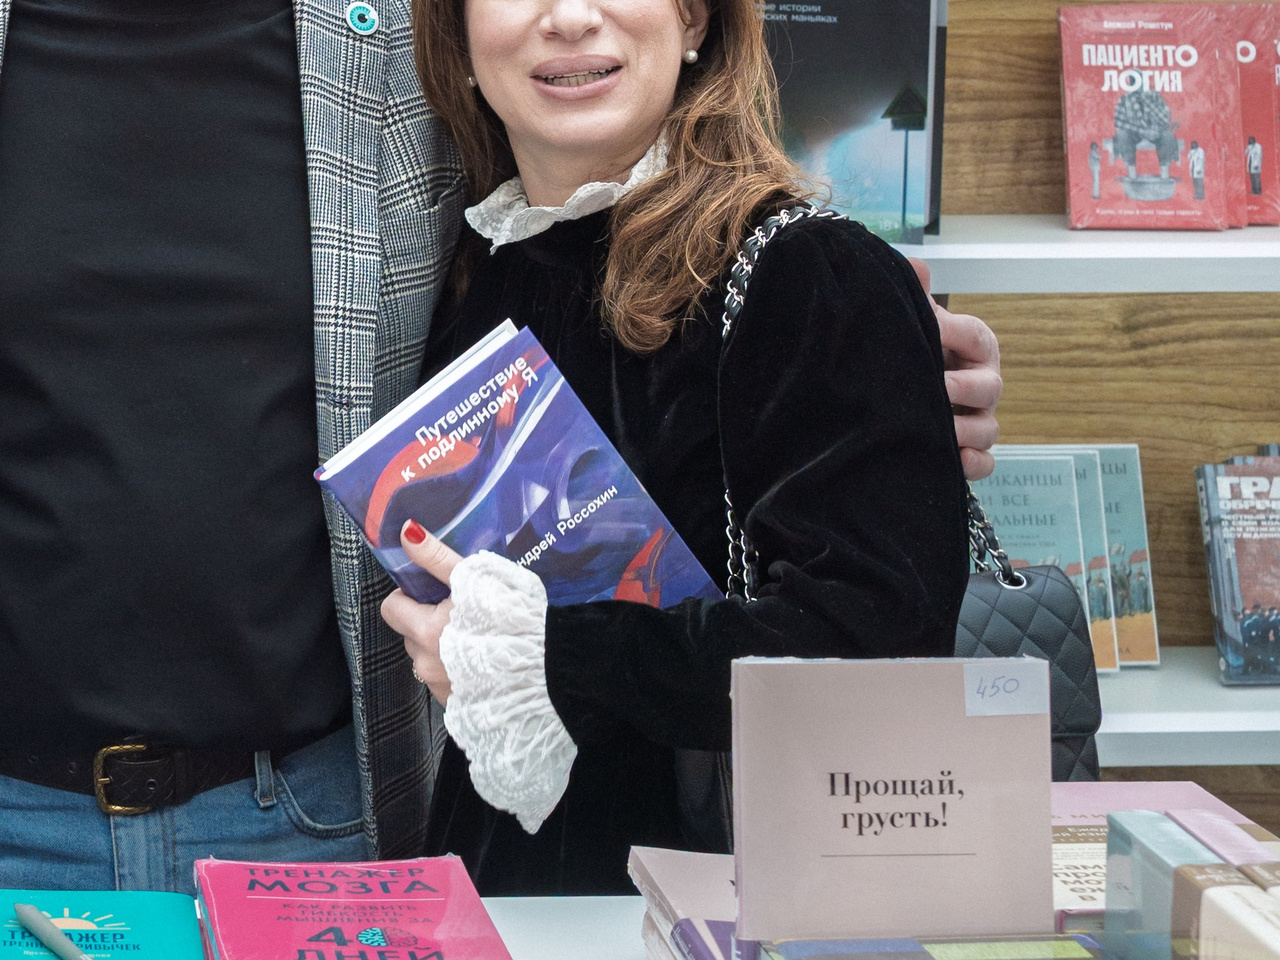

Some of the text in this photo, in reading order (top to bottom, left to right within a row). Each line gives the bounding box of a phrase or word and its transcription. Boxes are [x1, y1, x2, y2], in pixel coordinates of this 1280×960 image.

[779, 4, 821, 13] истории
[791, 15, 838, 24] маньяках
[1081, 43, 1199, 70] ПАЦИЕНТО
[1101, 69, 1183, 93] ЛОГИЯ
[414, 357, 527, 447] Путешествие
[417, 384, 519, 469] подлинному
[521, 366, 539, 387] Я
[1002, 494, 1031, 507] ВСЕ
[516, 485, 618, 567] ндрей Россохин
[976, 675, 1020, 700] 450
[827, 770, 965, 803] Прощай,
[840, 801, 948, 837] грусть!
[244, 867, 425, 879] ТРЕНАЖЕР
[247, 878, 440, 894] МОЗГА
[8, 930, 125, 943] ТРАЖЕР
[75, 943, 141, 951] РИВЫЧЕК
